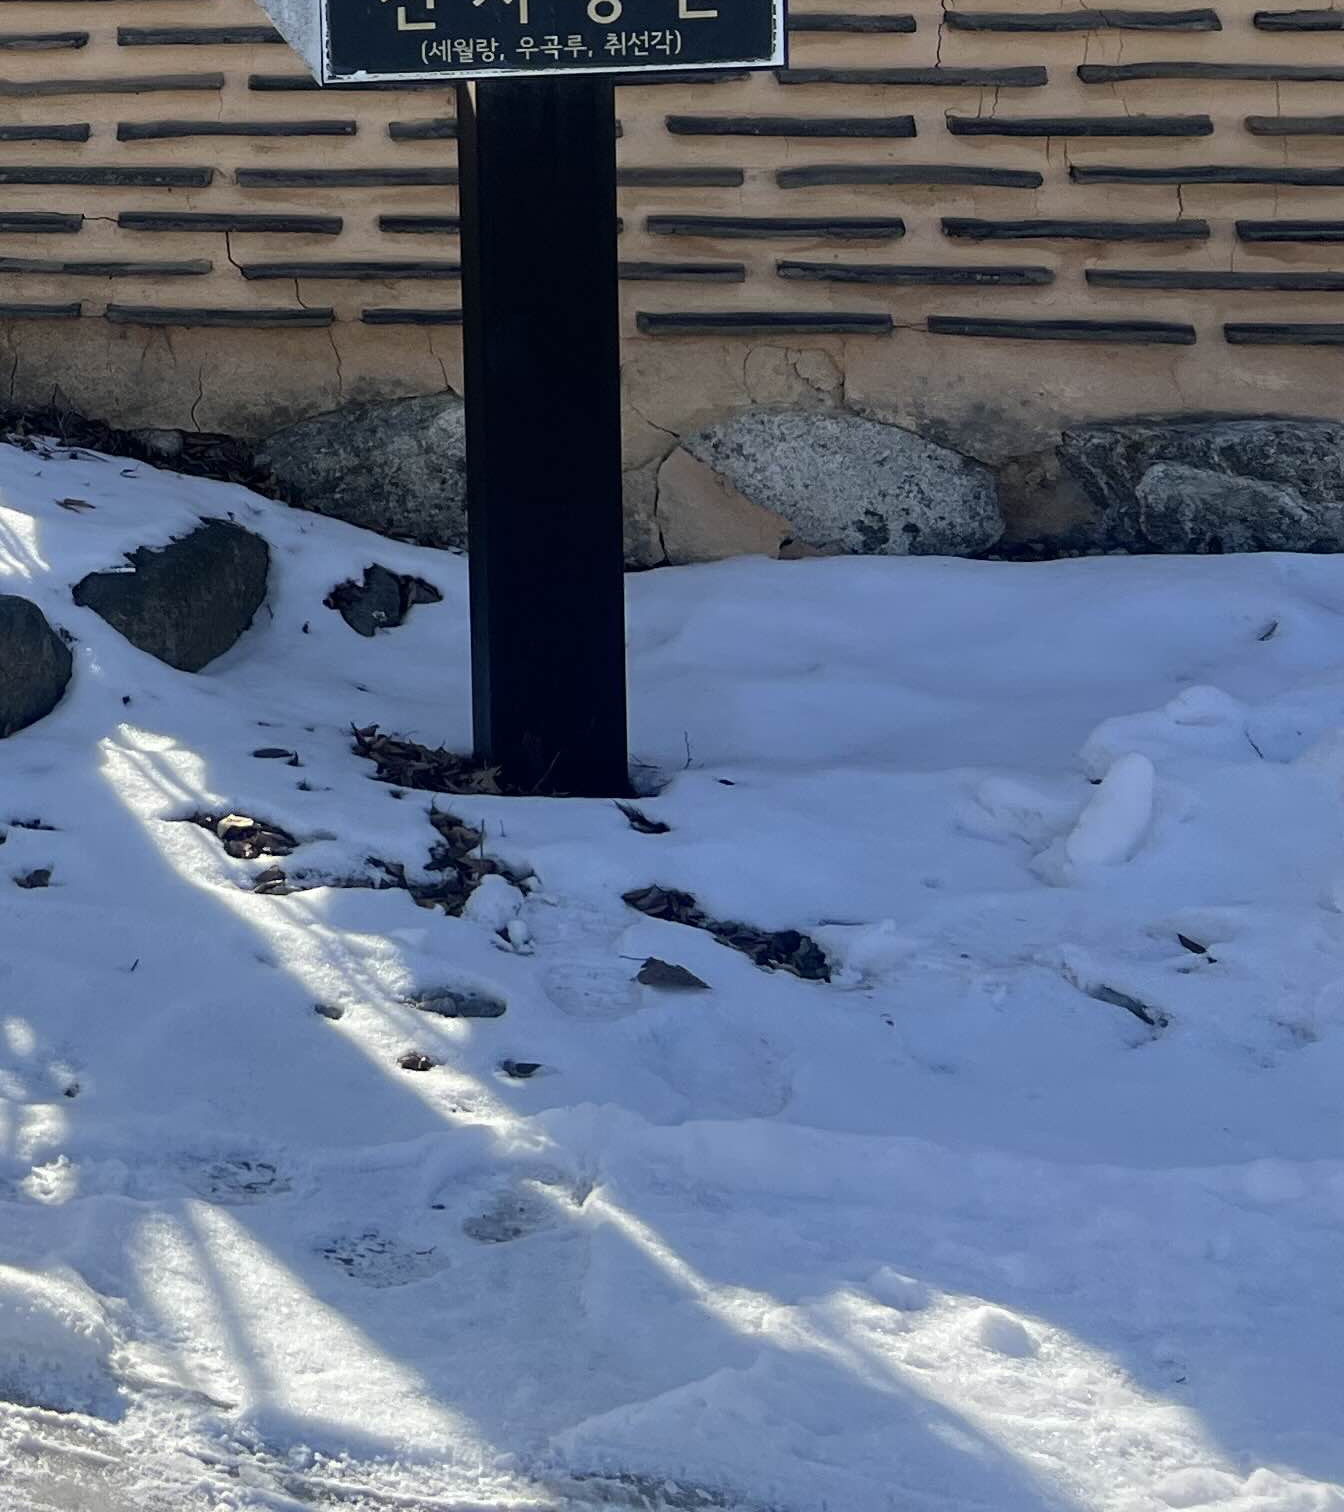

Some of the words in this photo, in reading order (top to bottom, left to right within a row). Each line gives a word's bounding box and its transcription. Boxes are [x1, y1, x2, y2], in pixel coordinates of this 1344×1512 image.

[420, 37, 505, 64] (세월랑,
[514, 35, 593, 59] 우곡루,
[603, 29, 683, 56] 취선각)
